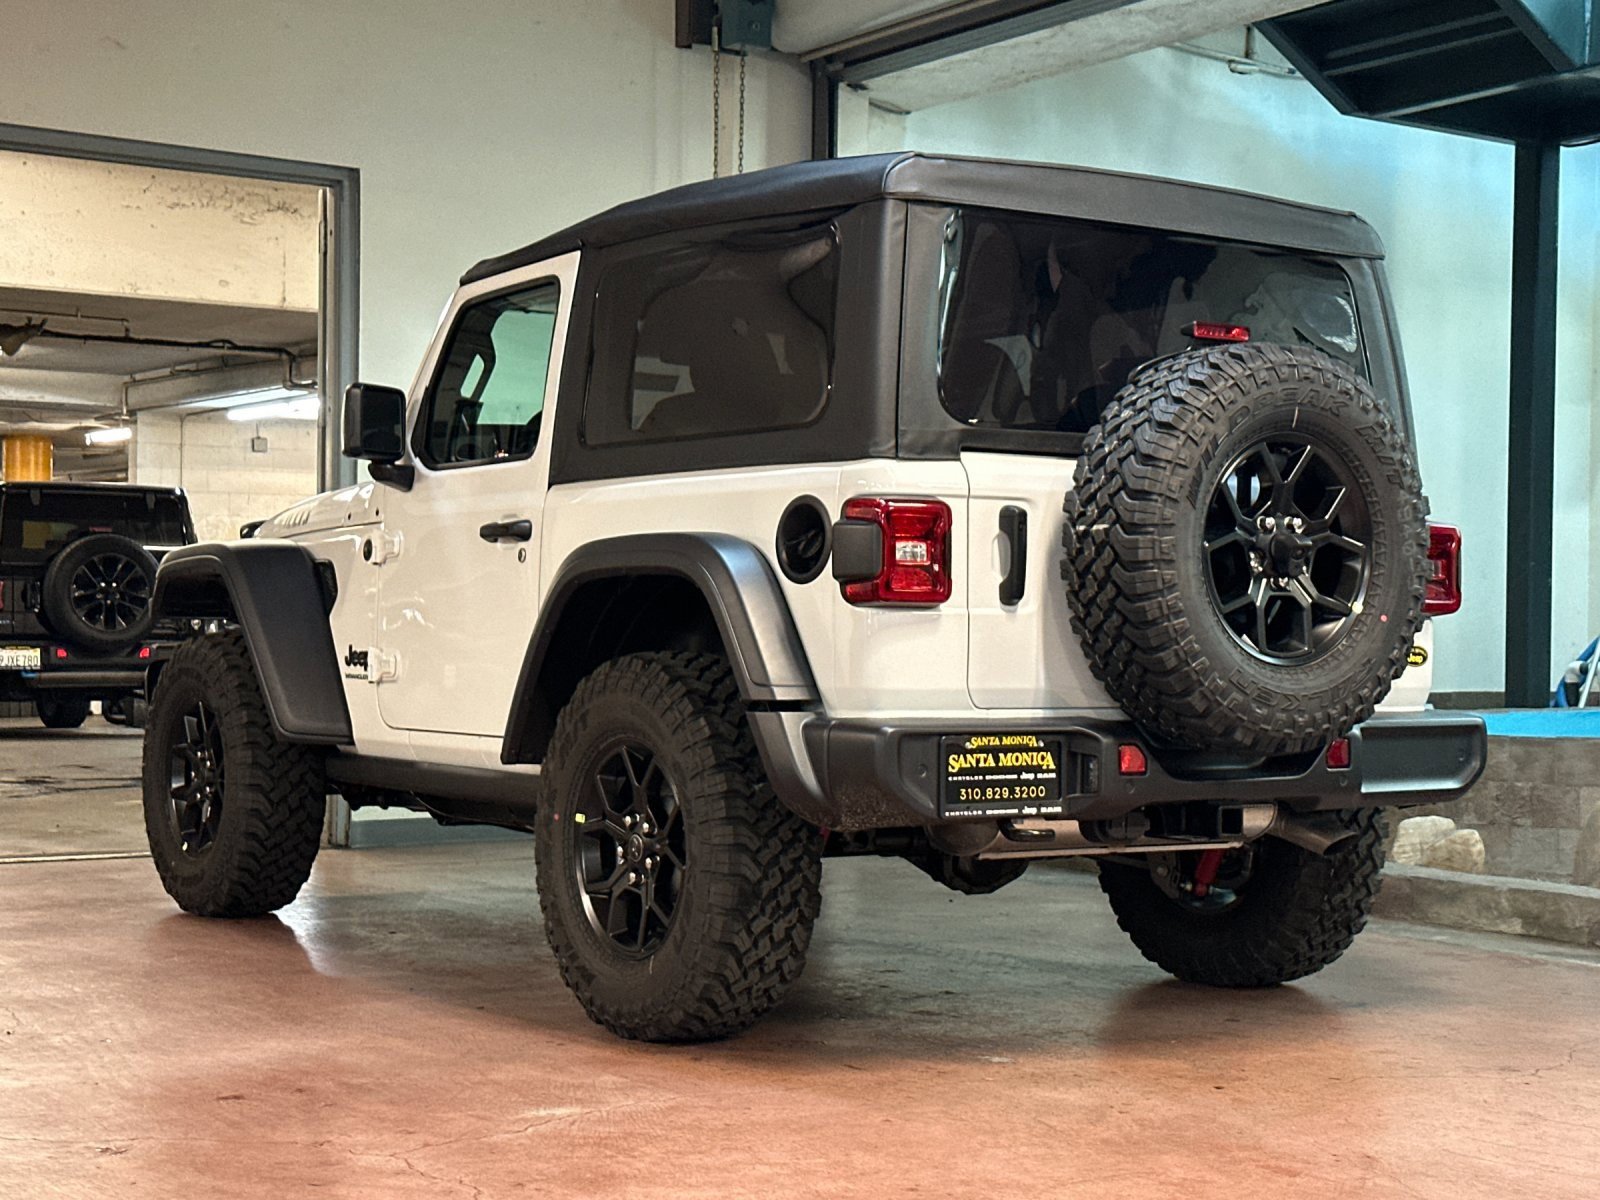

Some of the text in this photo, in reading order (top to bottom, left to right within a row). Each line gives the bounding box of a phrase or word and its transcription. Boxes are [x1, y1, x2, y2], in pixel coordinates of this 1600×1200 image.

[344, 644, 368, 672] Jeep
[970, 735, 1038, 749] SANTA MONICA
[948, 751, 1056, 773] SANTA MONICA
[959, 785, 1046, 801] 310.829.3200
